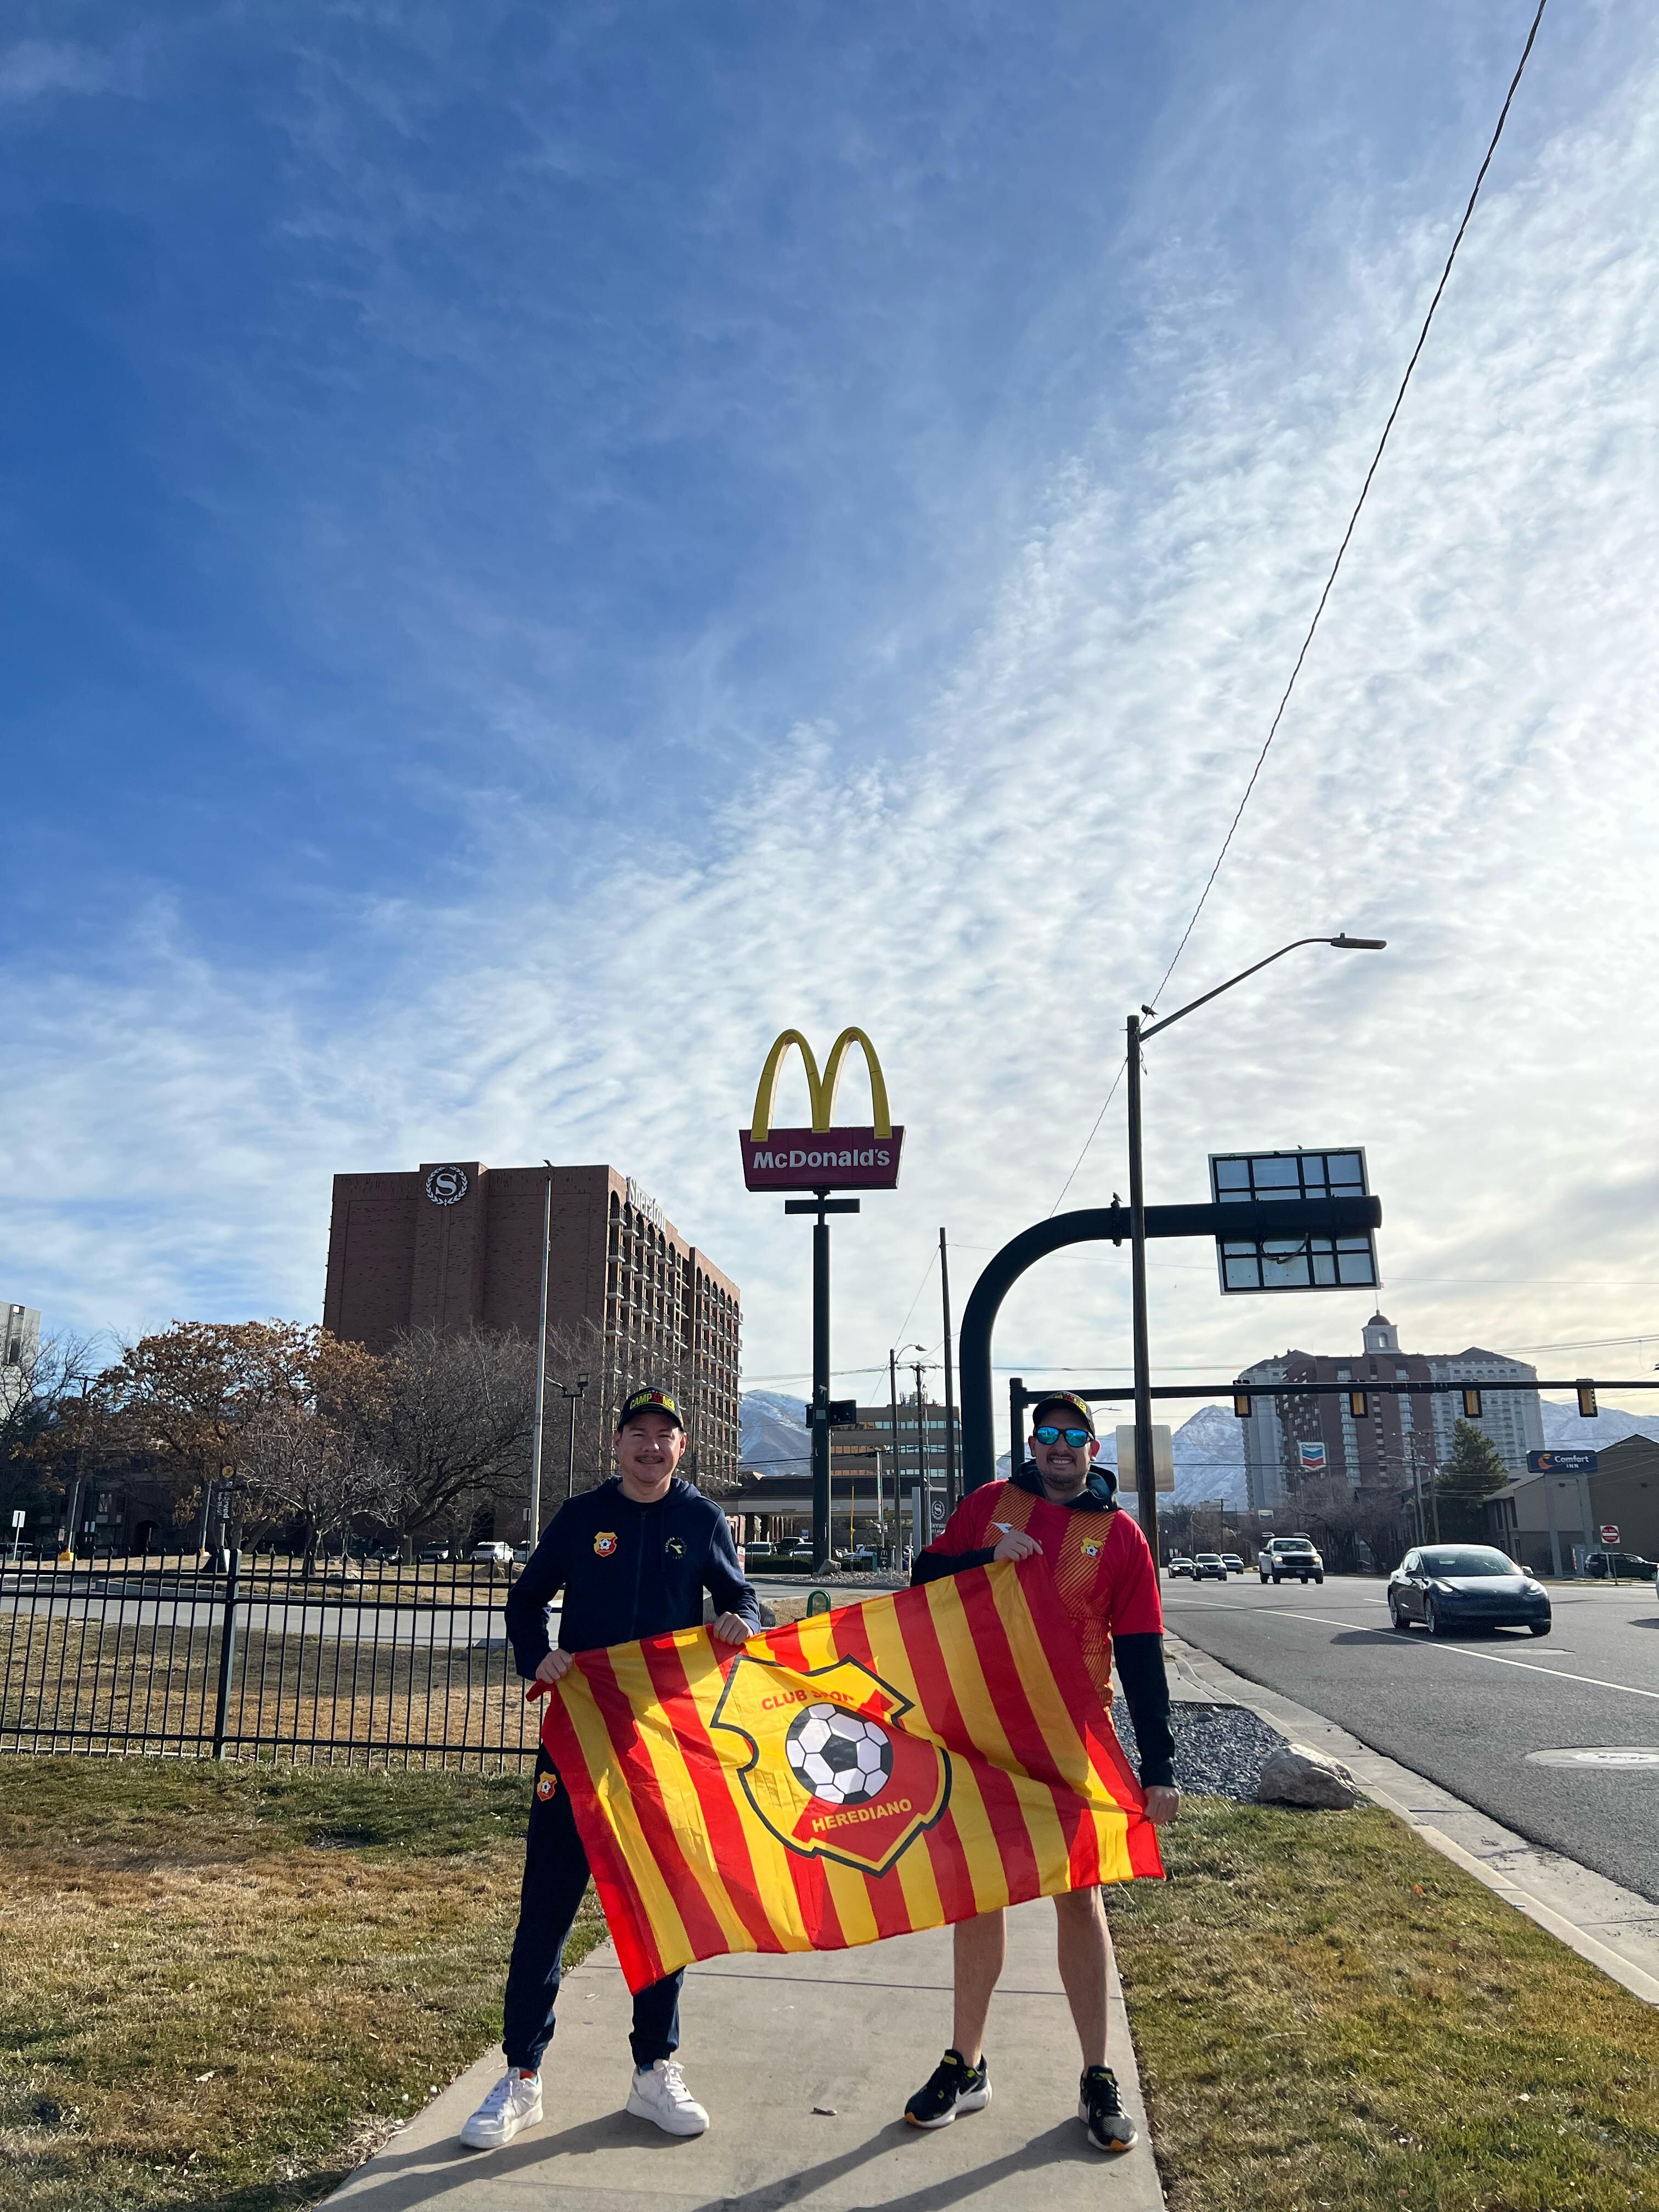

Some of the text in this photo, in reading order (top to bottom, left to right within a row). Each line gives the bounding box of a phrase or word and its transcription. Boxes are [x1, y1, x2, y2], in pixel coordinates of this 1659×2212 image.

[753, 1149, 890, 1169] McDonald's
[436, 1173, 456, 1196] S
[628, 1177, 667, 1234] Sheraton
[934, 1503, 942, 1516] S
[761, 1690, 808, 1711] CLUB
[811, 1798, 912, 1833] HEREDIANO
